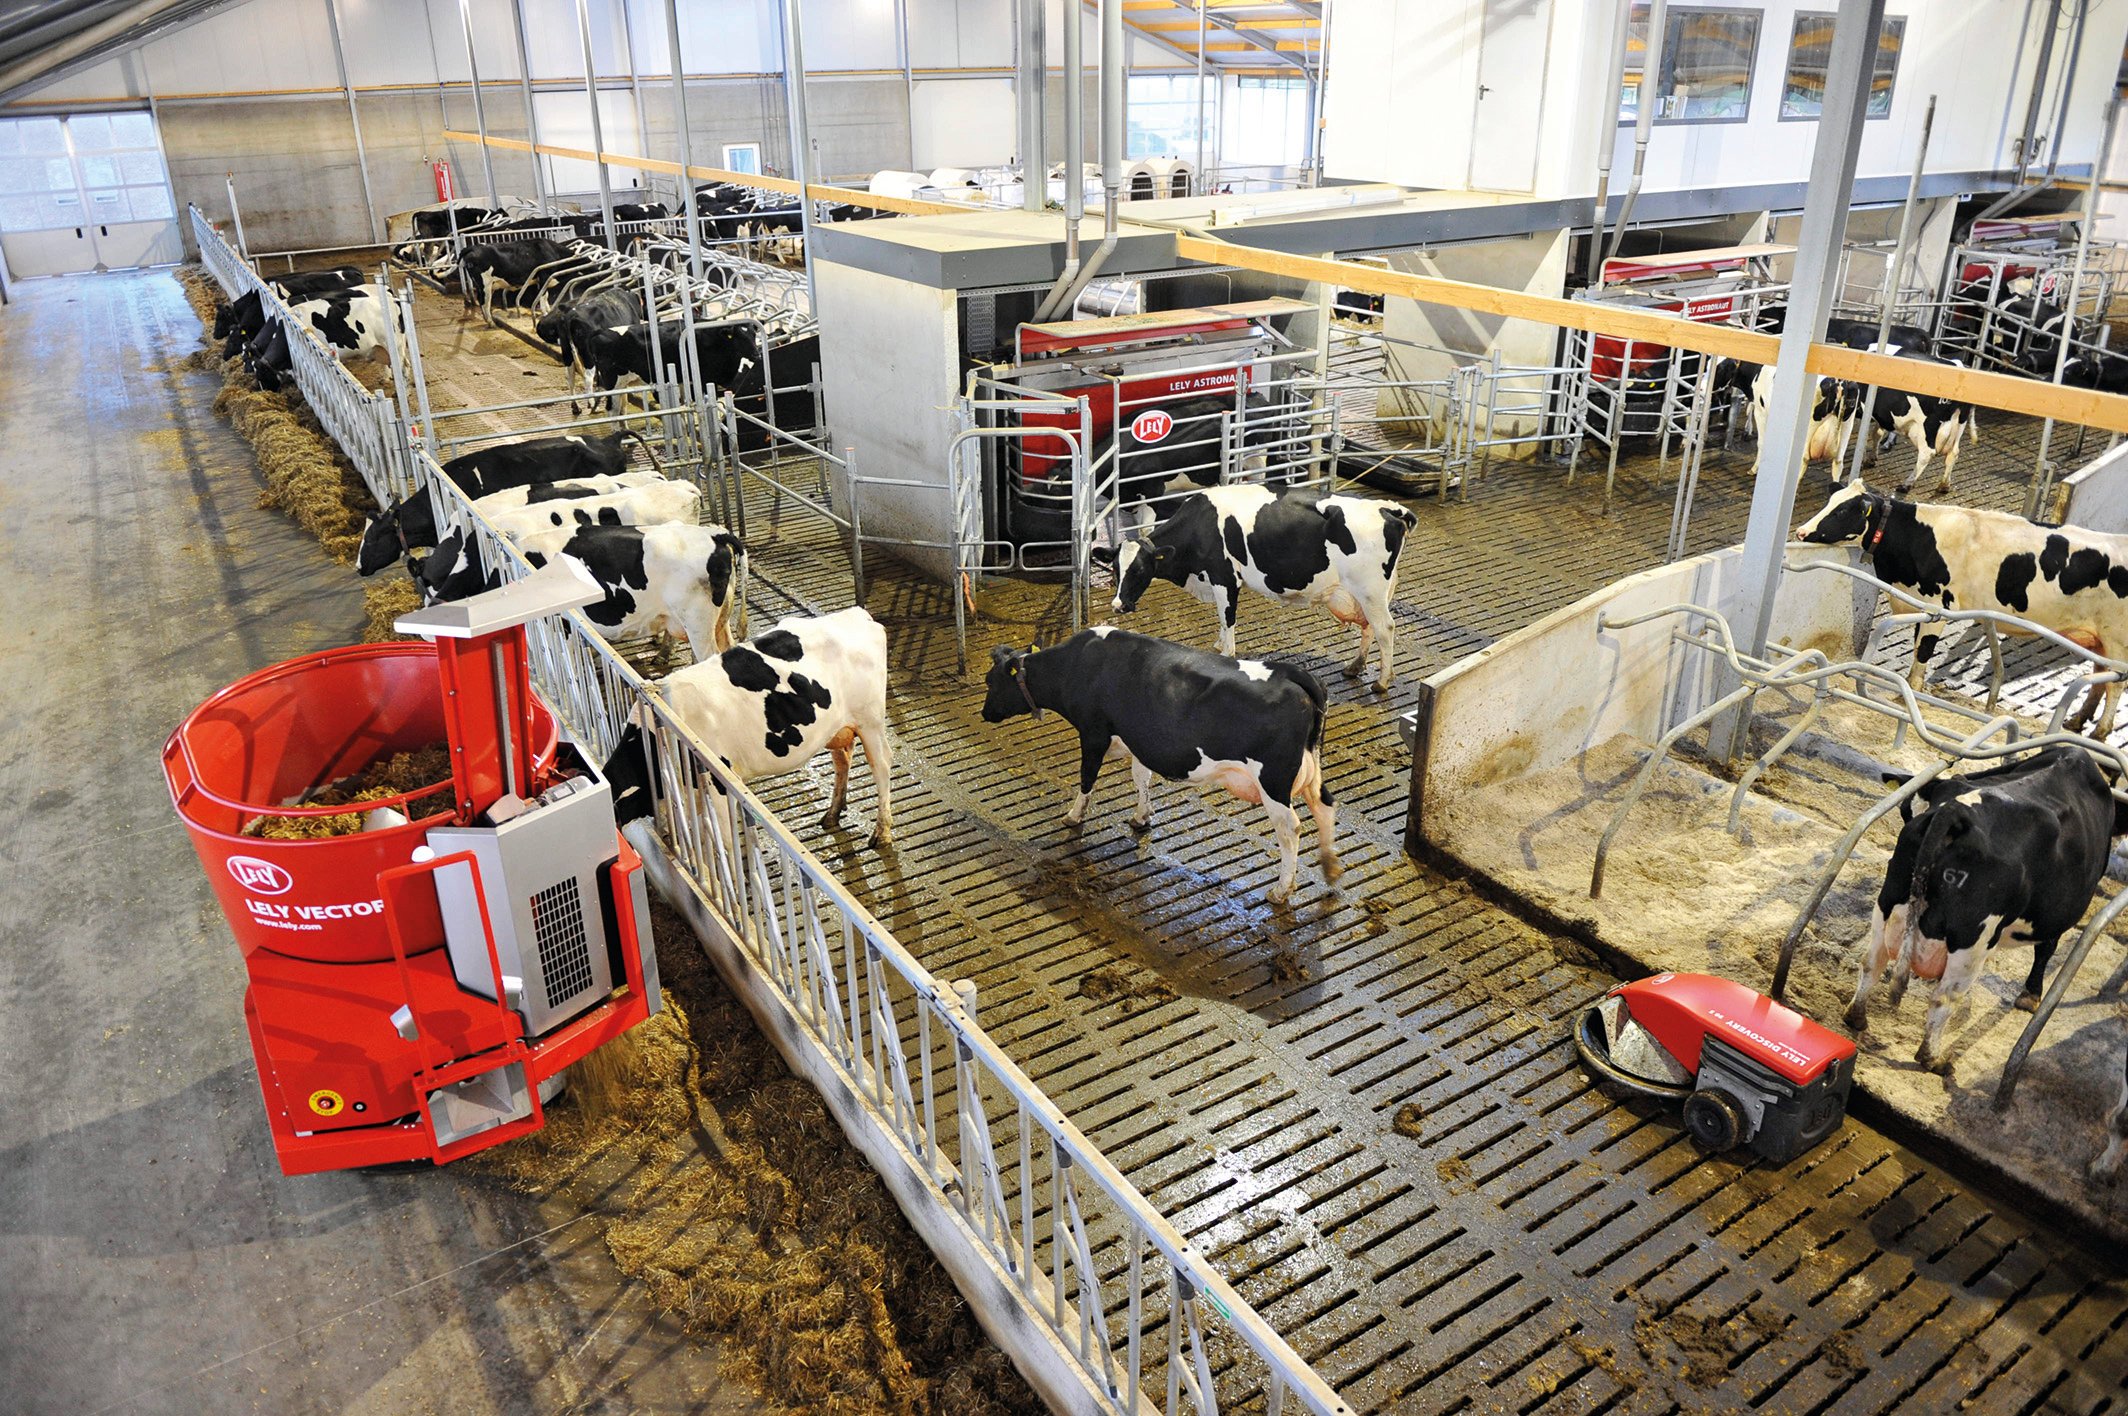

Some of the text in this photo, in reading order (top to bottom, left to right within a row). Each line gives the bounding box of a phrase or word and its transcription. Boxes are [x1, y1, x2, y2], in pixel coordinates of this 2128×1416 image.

[1170, 374, 1237, 391] LELY ASTRONA
[1140, 416, 1166, 439] LELY
[235, 862, 279, 888] LELY
[1943, 868, 1969, 888] 67
[245, 898, 290, 919] LELY
[254, 917, 322, 931] www.lely.com
[1726, 1020, 1781, 1052] DISCOVERY
[1782, 1051, 1806, 1066] LELY
